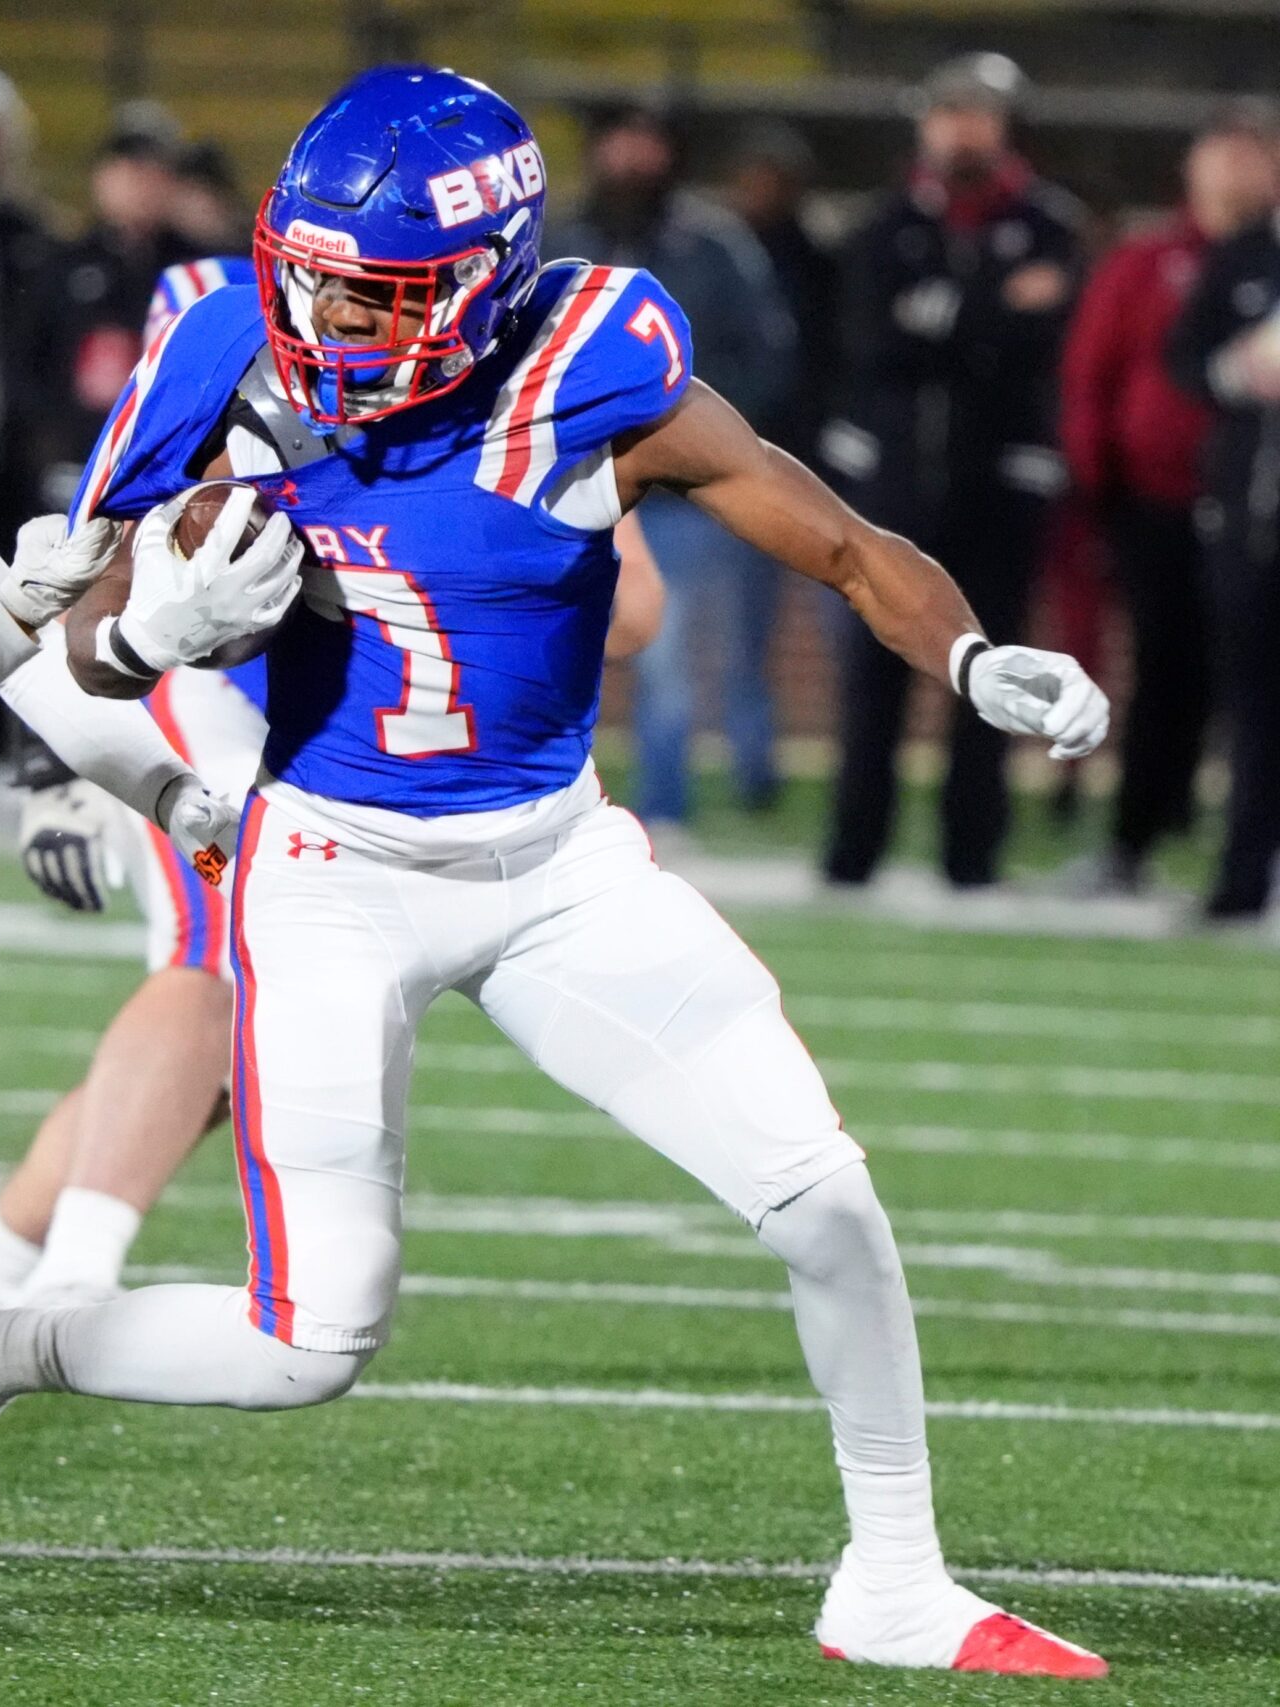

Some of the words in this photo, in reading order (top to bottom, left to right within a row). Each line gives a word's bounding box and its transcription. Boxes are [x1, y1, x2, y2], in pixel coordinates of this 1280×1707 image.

[292, 226, 347, 254] Riddell
[624, 297, 686, 394] 7
[299, 560, 479, 761] 7
